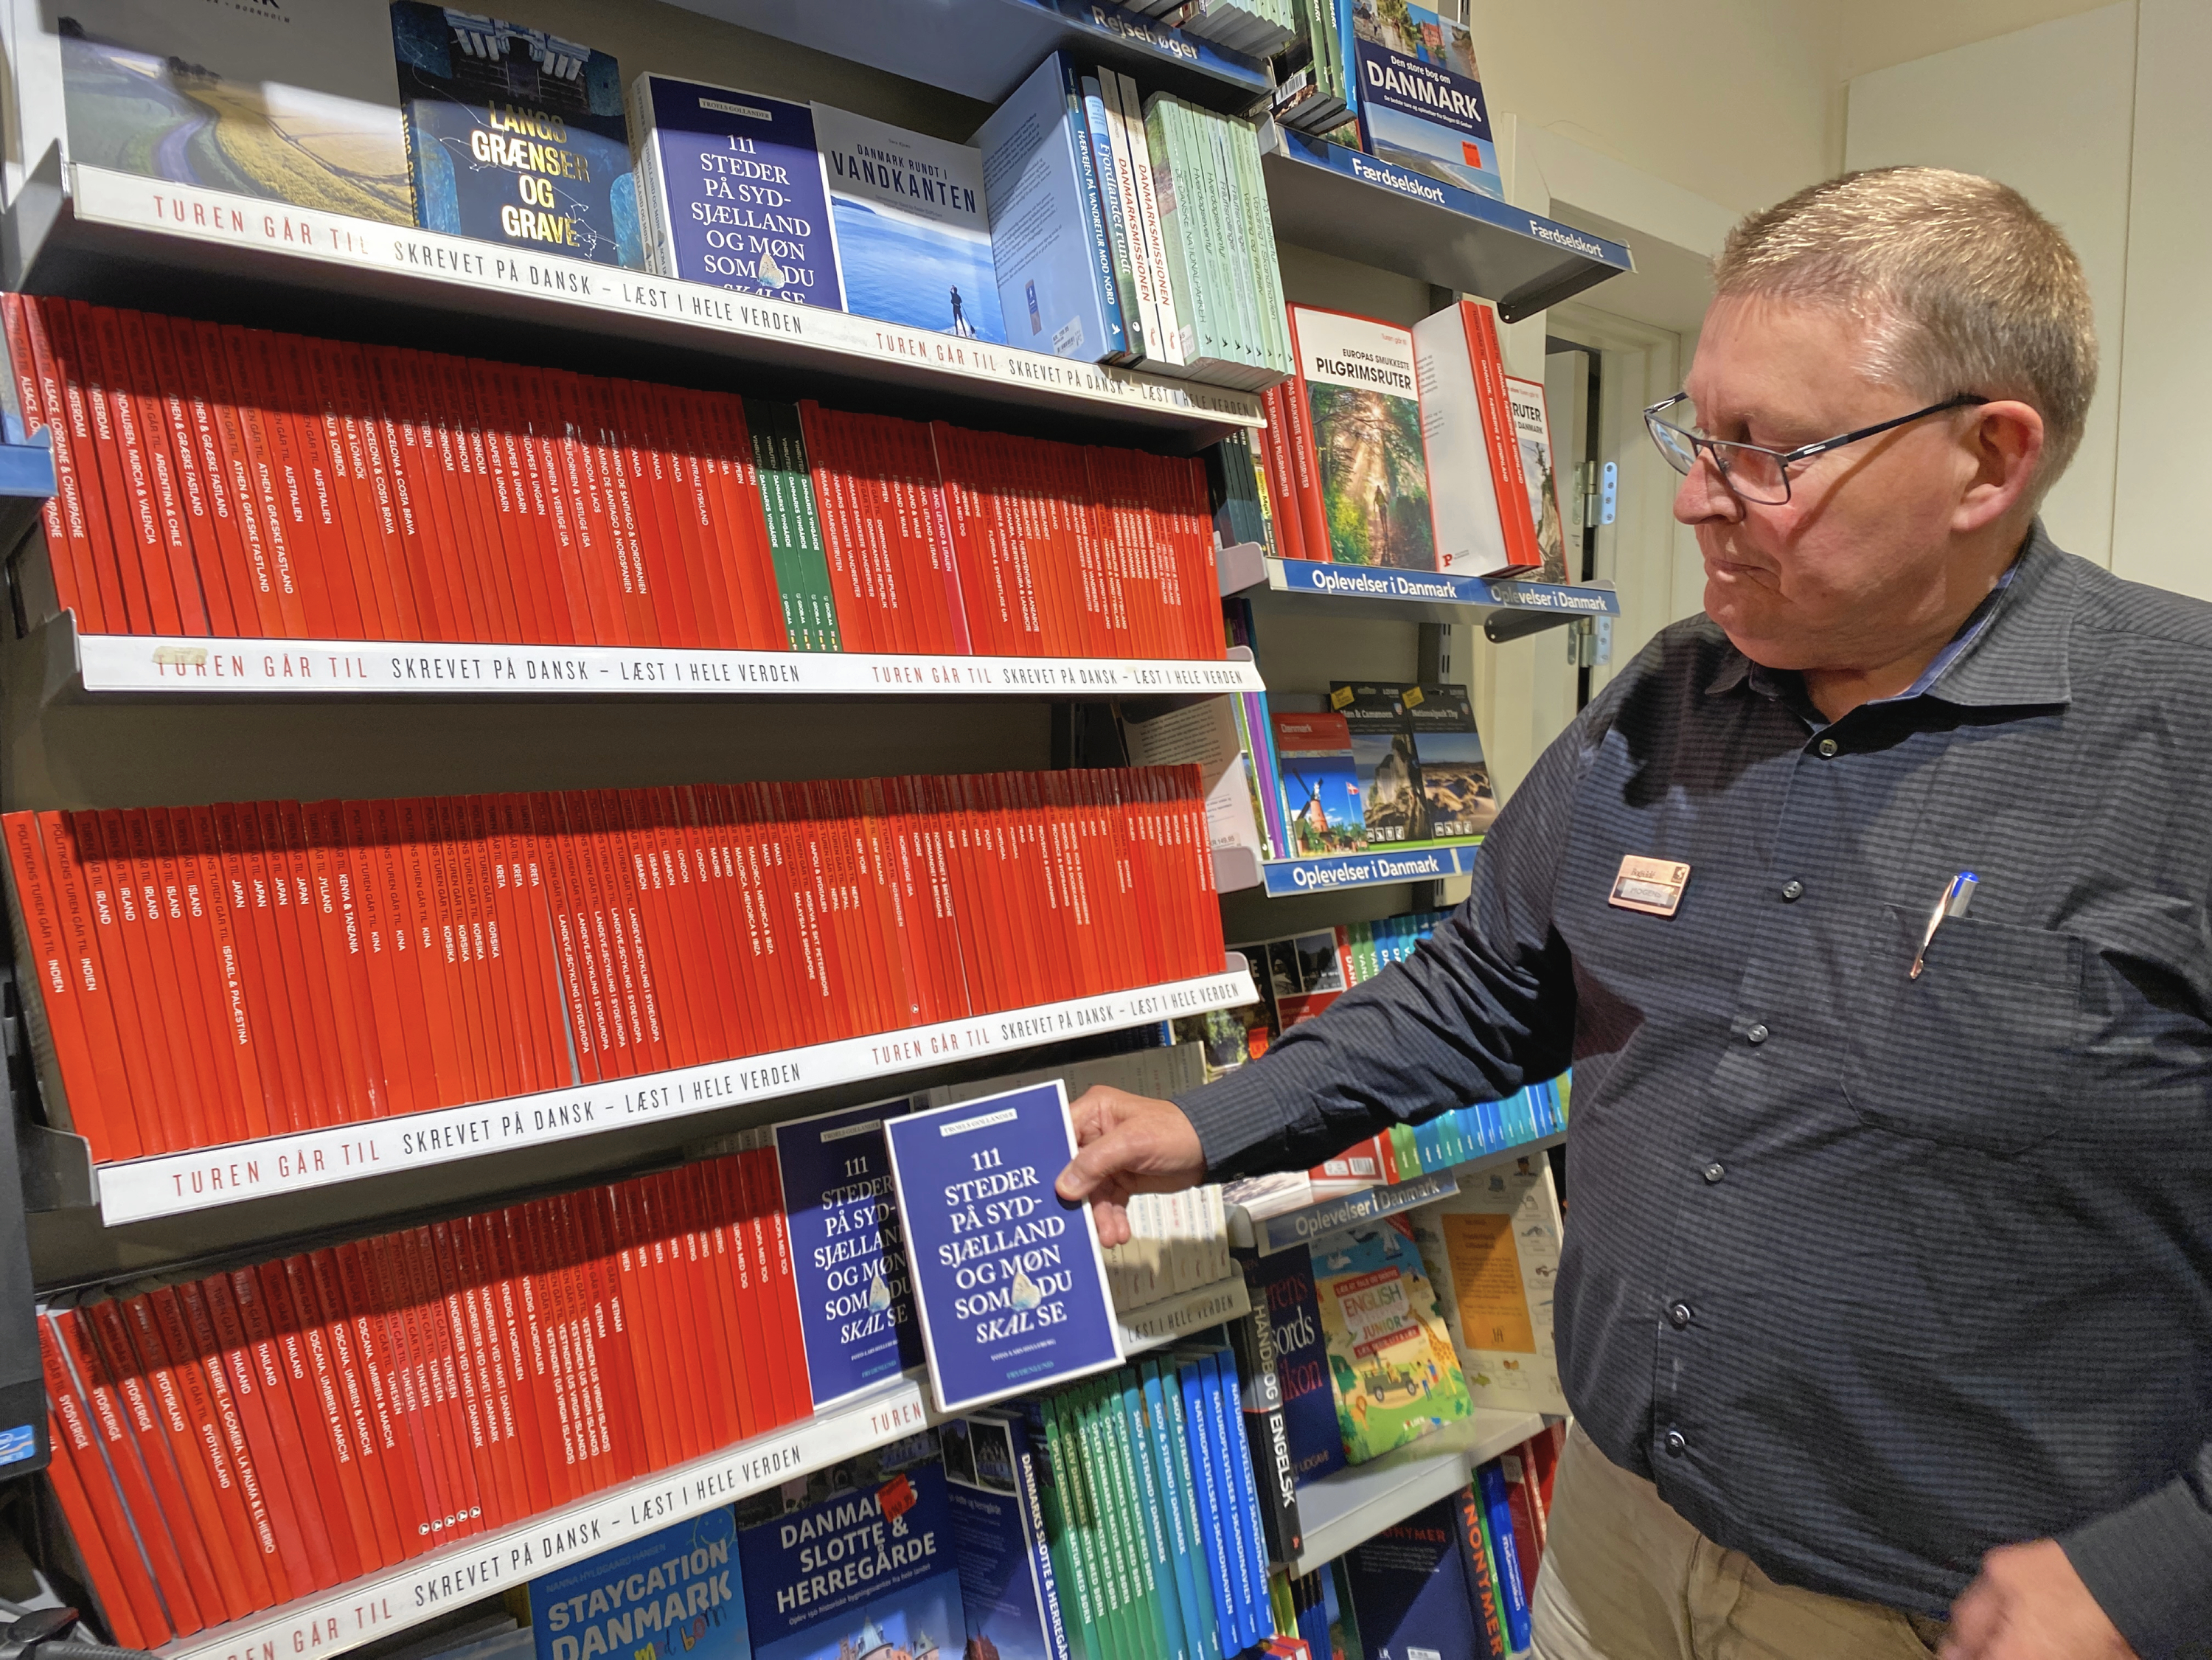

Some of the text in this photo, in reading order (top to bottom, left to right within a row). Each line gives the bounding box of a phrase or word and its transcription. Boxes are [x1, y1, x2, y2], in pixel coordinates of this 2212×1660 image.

[1091, 5, 1198, 60] Rejsebøger
[1366, 60, 1481, 122] DANMARK
[1391, 55, 1450, 84] Den store bog om
[489, 100, 567, 143] LANGS
[701, 100, 770, 119] TROELS GOLLANDER
[471, 130, 590, 183] GRÆNSER
[727, 134, 756, 154] 111
[857, 144, 947, 180] DANMARK RUNDT I
[700, 153, 790, 185] STEDER
[831, 150, 976, 214] VANDKANTEN
[1352, 158, 1445, 204] Færdselskort
[519, 175, 554, 209] OG
[704, 177, 791, 207] PÅ SYD-
[1099, 143, 1130, 274] Fjordlandet rundt
[153, 195, 369, 255] TUREN GÅR TIL
[501, 205, 580, 247] GRAVE
[691, 202, 810, 237] SJÆLLAND
[1078, 130, 1115, 305] HÆRVEJEN PÅ VANDRETUR MOD NORD
[1119, 158, 1150, 302] DANMARKSMISSIONEN
[1530, 220, 1604, 258] Færdselskort
[706, 230, 805, 261] OG MØN
[394, 240, 803, 334] SKREVET PÅ DANSK LÆST I HELE VERDEN
[704, 255, 814, 287] SOM DU
[1316, 357, 1412, 390] PILGRIMSRUTER
[1343, 348, 1410, 371] EUROPAS SMUKKESTE
[44, 377, 59, 414] ALSACE,
[91, 381, 111, 440] AMSTERDAM
[51, 417, 69, 465] LORRAINE
[1290, 397, 1310, 488] SMUKKESTE PILGRIMSRUTER
[63, 475, 84, 538] CHAMPAGNE
[759, 474, 778, 548] DANMARKS VINGÅRDE
[1312, 569, 1458, 599] Oplevelser i Danmark
[1492, 586, 1607, 611] Oplevelser i Danmark
[156, 653, 367, 679] TUREN GÅR TIL
[392, 656, 800, 684] SKREVET PÅ DANSK LÆST I HELE VERDEN
[1281, 723, 1312, 734] Danmark
[872, 837, 885, 885] NEW ZEALAND
[996, 827, 1006, 861] PORTUGAL
[1293, 855, 1439, 889] Oplevelser i Danmark
[95, 890, 111, 925] IRLAND
[891, 882, 904, 928] NORDINDIEN
[488, 920, 500, 959] KORSIKA
[48, 959, 65, 993] INDIEN
[223, 945, 236, 979] ISRAEL
[231, 990, 248, 1046] PALÆSTINA
[558, 914, 590, 1054] LANDEVEJSCYKLING SYDEUROPA
[403, 1063, 801, 1156] SKREVET PÅ DANSK LÆST I HELE VERDEN
[173, 1140, 380, 1198] TUREN GÅR TIL
[844, 1156, 869, 1178] 111
[971, 1147, 1003, 1171] 111
[821, 1175, 894, 1210] STEDER
[945, 1165, 1040, 1206] STEDER
[825, 1204, 897, 1237] PÅ SYD-
[950, 1195, 1043, 1234] PÅ SYD-
[1295, 1178, 1440, 1237] Oplevelser i Danmark
[753, 1217, 768, 1283] EUROPA MED TOG
[939, 1216, 1065, 1268] SJÆLLAND
[827, 1250, 906, 1291] OG MØN
[956, 1244, 1062, 1290] OG MØN
[611, 1296, 623, 1333] VIETNAM
[825, 1279, 913, 1321] SOM DU
[955, 1271, 1072, 1319] SOM DU
[1343, 1283, 1402, 1317] ENGLISH
[841, 1304, 908, 1344] SKAL SE
[976, 1302, 1068, 1344] SKAL SE
[1363, 1315, 1402, 1340] JUNIOR
[258, 1343, 277, 1387] THAILAND
[59, 1395, 89, 1450] SYDSVERIGE
[202, 1424, 231, 1489] SYDTHAILAND
[1270, 1414, 1295, 1508] ENGELSK
[781, 1480, 918, 1549] DANMA
[1117, 1411, 1155, 1591] OPLEV DANMARKS NATUR MED BØRN
[1213, 1392, 1251, 1605] NATUROPLEVELSER SKANDINAVIEN
[1021, 1454, 1054, 1590] DANMARKS SLOTTE &
[800, 1515, 909, 1573] SLOTTE &
[549, 1538, 728, 1632] STAYCATION
[776, 1530, 936, 1614] HERREGÅRDE
[1461, 1487, 1503, 1656] YNONYMER
[552, 1570, 732, 1660] DANMARK
